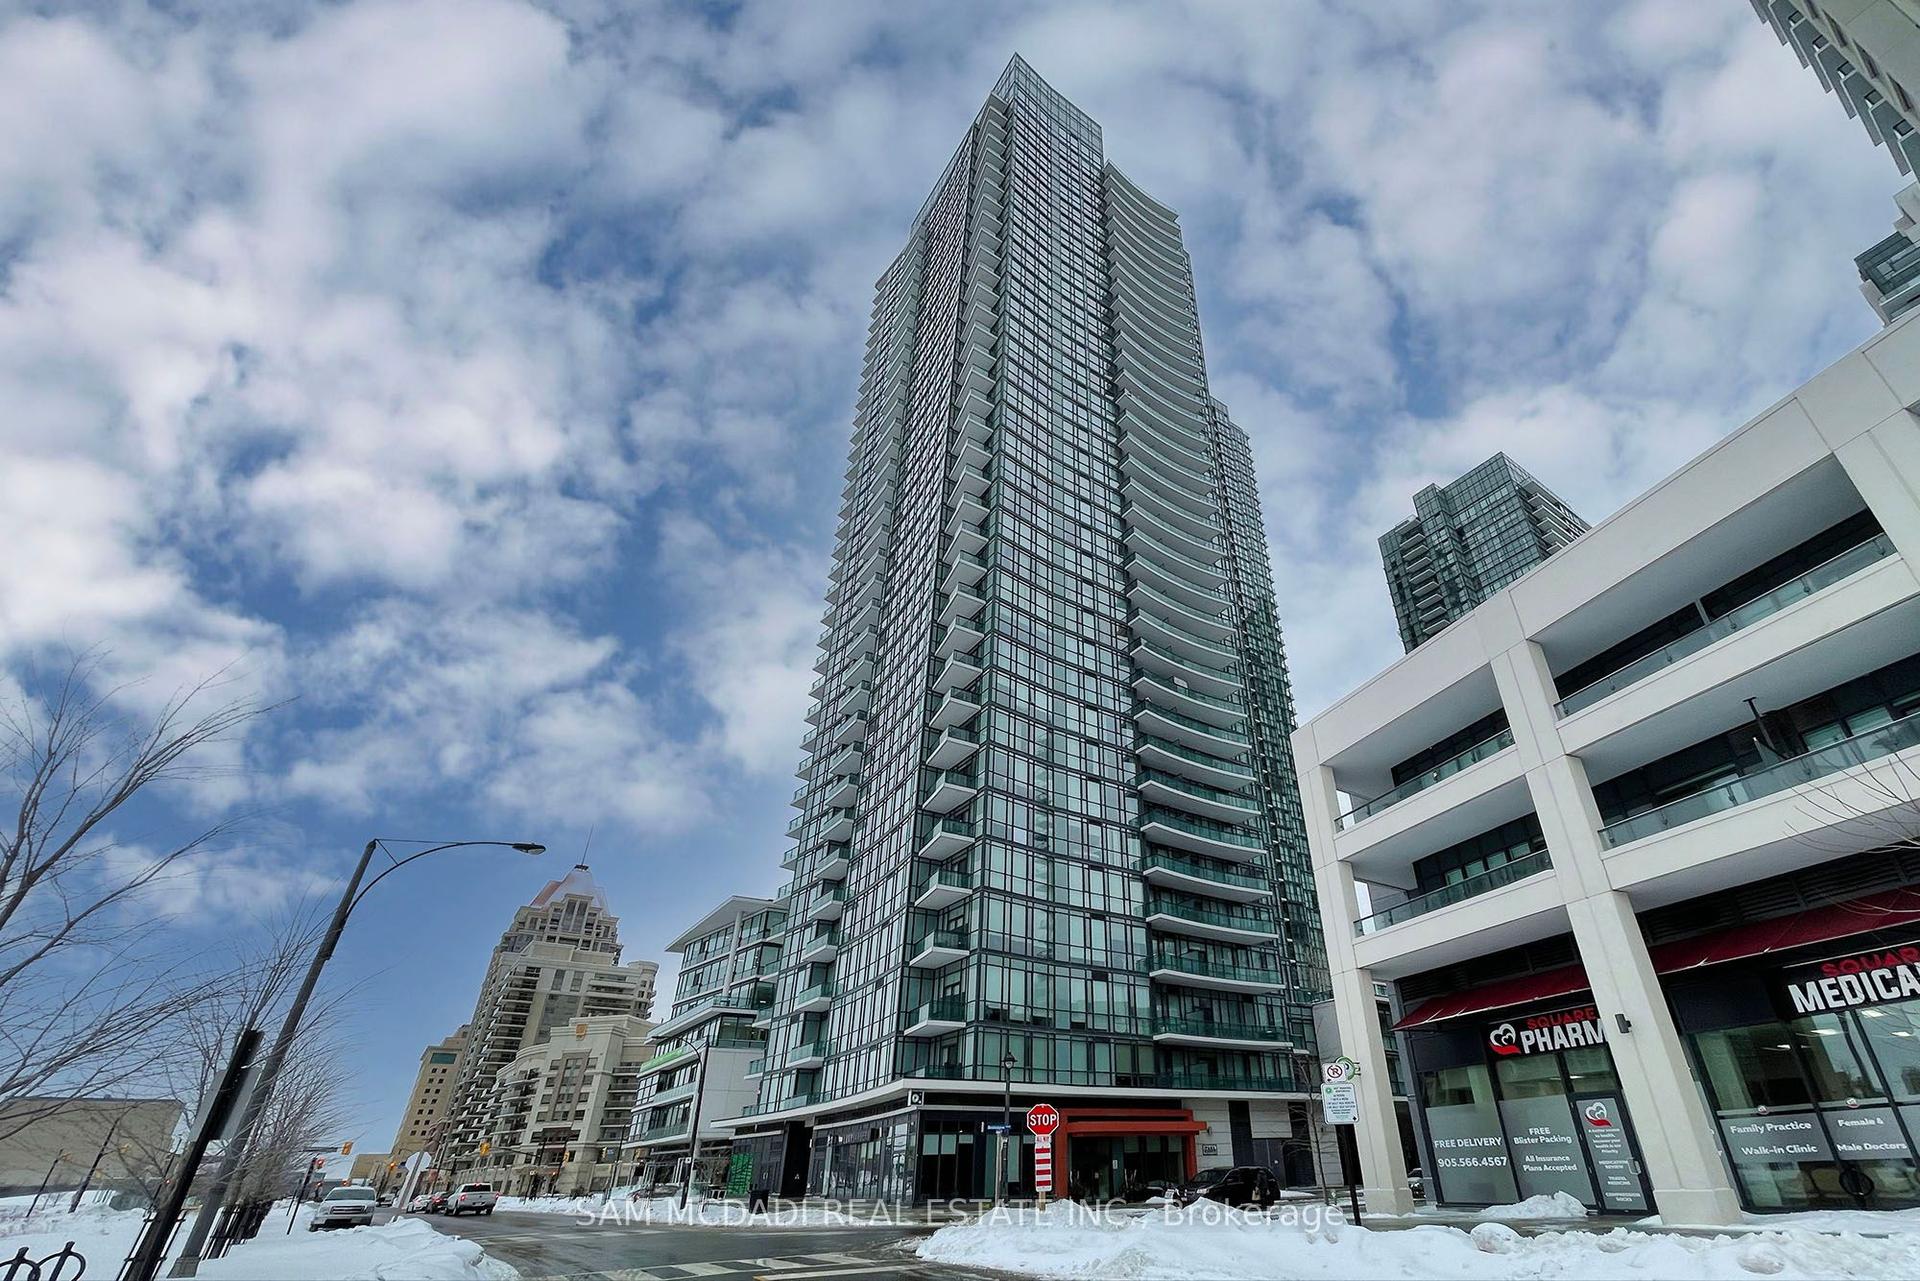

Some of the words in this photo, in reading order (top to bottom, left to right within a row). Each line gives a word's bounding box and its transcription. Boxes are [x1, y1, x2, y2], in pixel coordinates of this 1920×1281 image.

[1788, 962, 1920, 1013] MEDICA
[1526, 1007, 1597, 1029] SQUARE
[1030, 1114, 1057, 1126] STOP
[1838, 1118, 1874, 1127] Female
[1528, 1127, 1551, 1135] FREE
[1730, 1123, 1765, 1135] Family
[1766, 1120, 1812, 1132] Practice
[1434, 1138, 1457, 1148] FREE
[1457, 1136, 1502, 1147] DELIVERY
[1513, 1136, 1540, 1145] Blister
[1540, 1135, 1572, 1144] Packing
[1741, 1145, 1785, 1156] Walk-in
[1786, 1144, 1818, 1154] Clinic
[1837, 1143, 1863, 1152] Male
[1864, 1142, 1908, 1151] Doctors
[1438, 1156, 1507, 1168] 905.566.4567
[1523, 1164, 1543, 1172] Plans
[1543, 1163, 1577, 1173] Accepted
